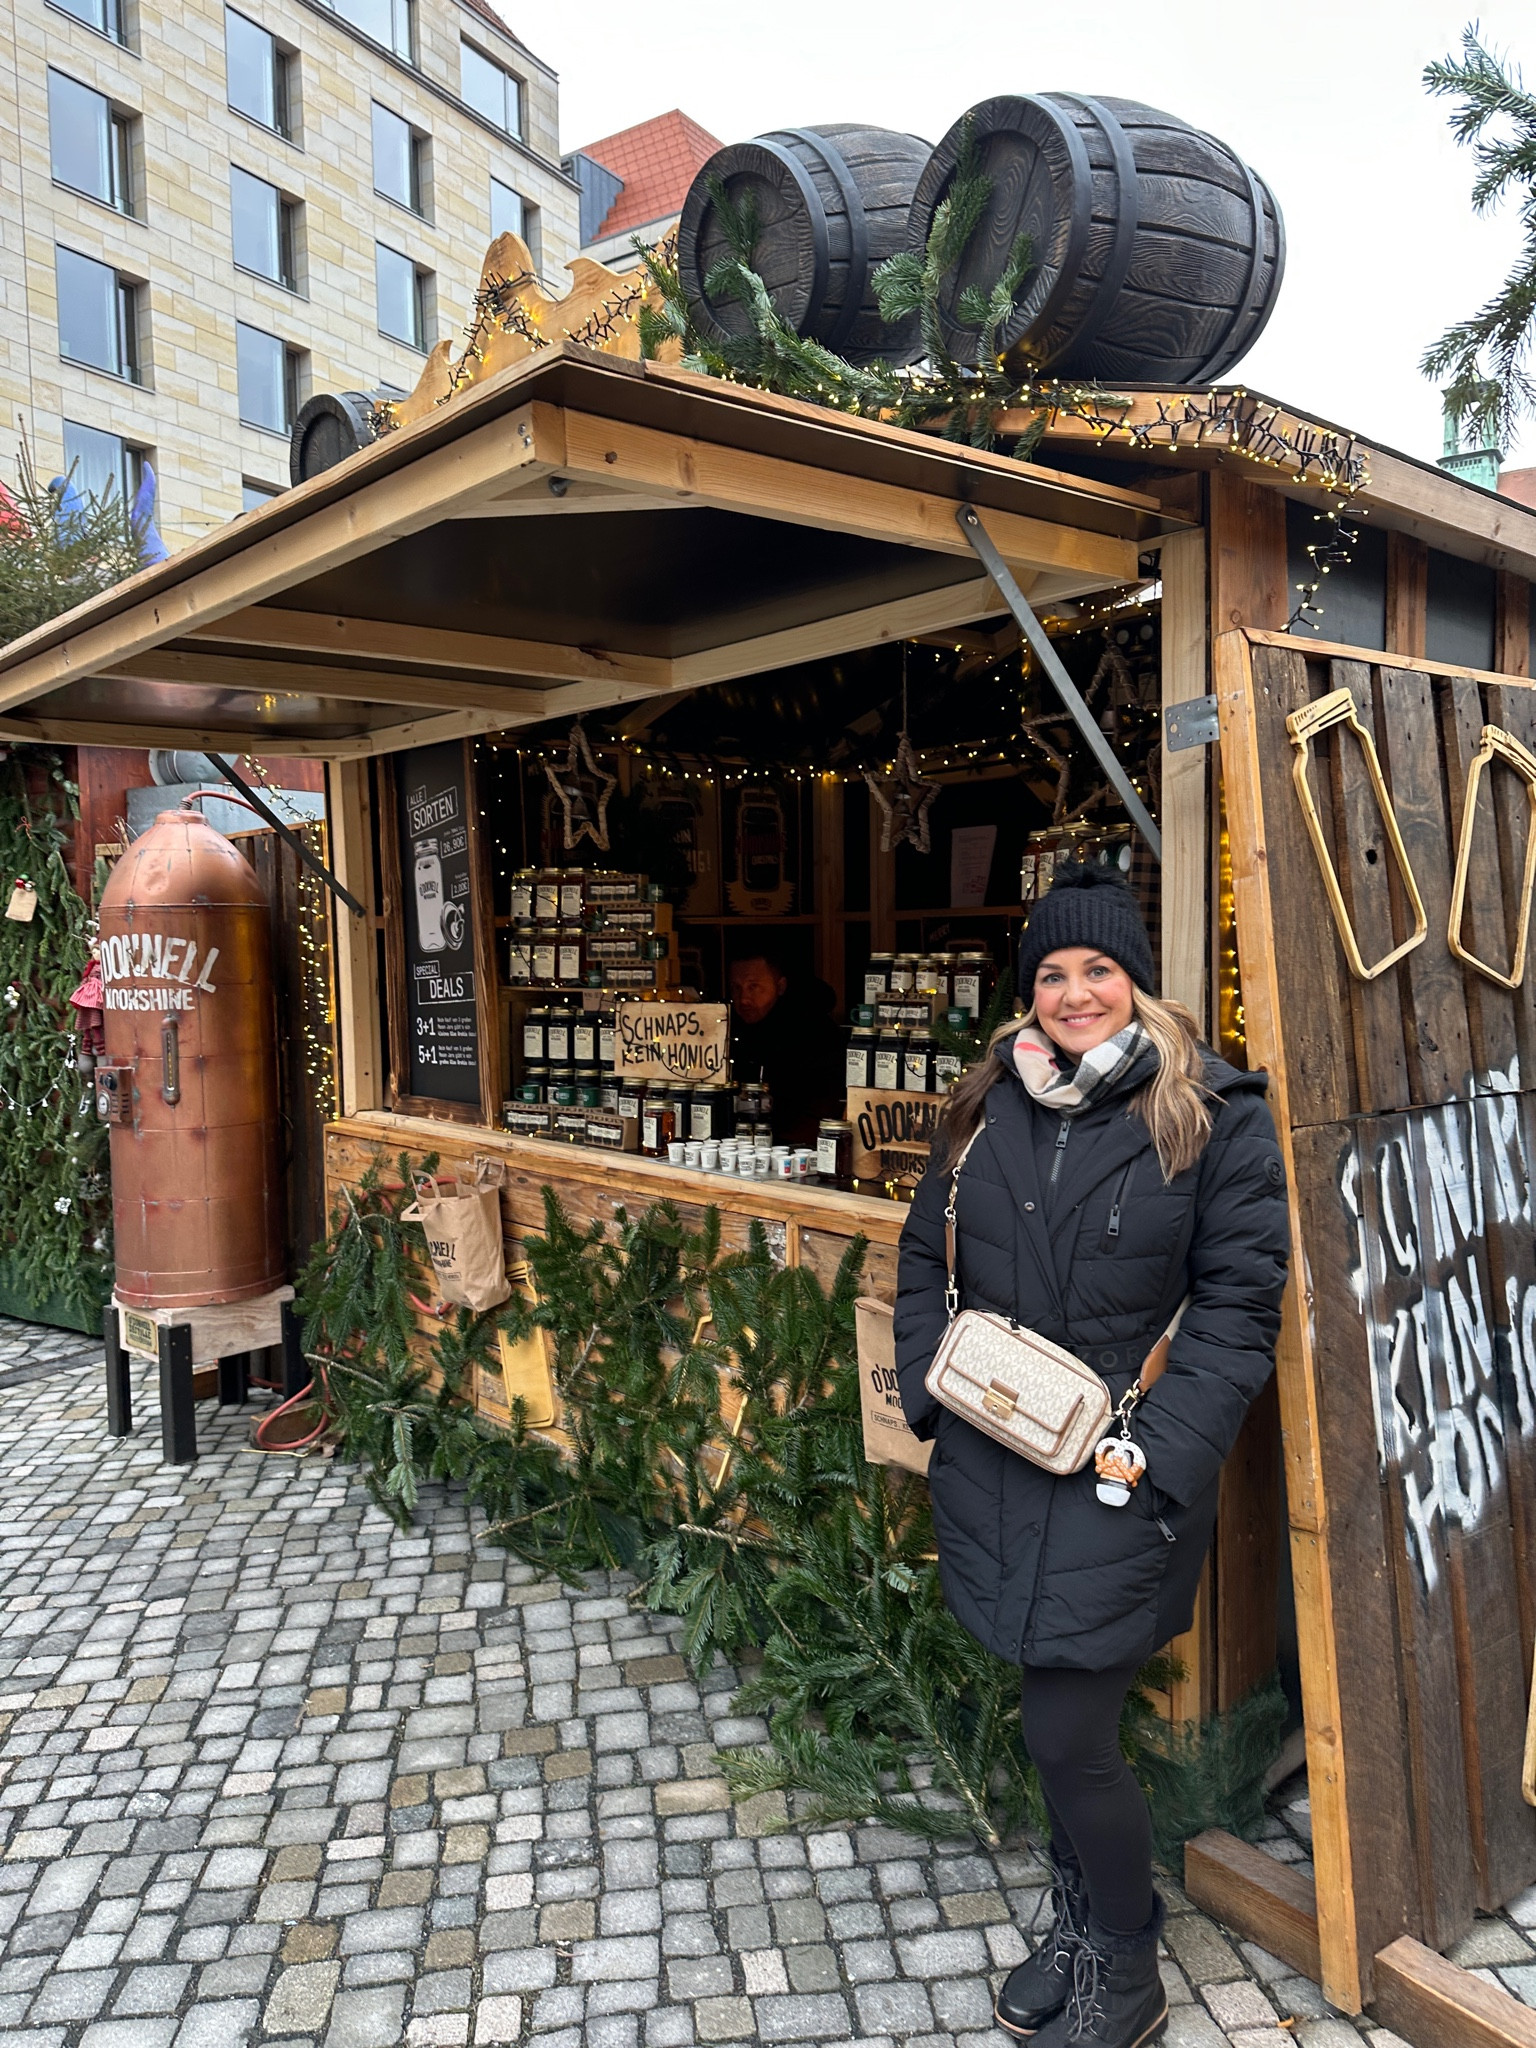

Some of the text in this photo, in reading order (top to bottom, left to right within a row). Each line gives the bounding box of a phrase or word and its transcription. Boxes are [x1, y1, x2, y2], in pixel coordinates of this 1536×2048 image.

[413, 794, 454, 830] SORTEN
[416, 965, 438, 976] SPECIAL
[105, 988, 195, 1011] MOONSHINE
[430, 977, 464, 998] DEALS
[416, 1017, 436, 1036] 3+1
[622, 1011, 704, 1044] SCHNAPS.
[418, 1045, 438, 1064] 5+1
[622, 1042, 660, 1067] KEIN
[668, 1042, 719, 1072] HONIG!
[858, 1100, 937, 1151] O'DONN
[881, 1149, 926, 1175] MOONS
